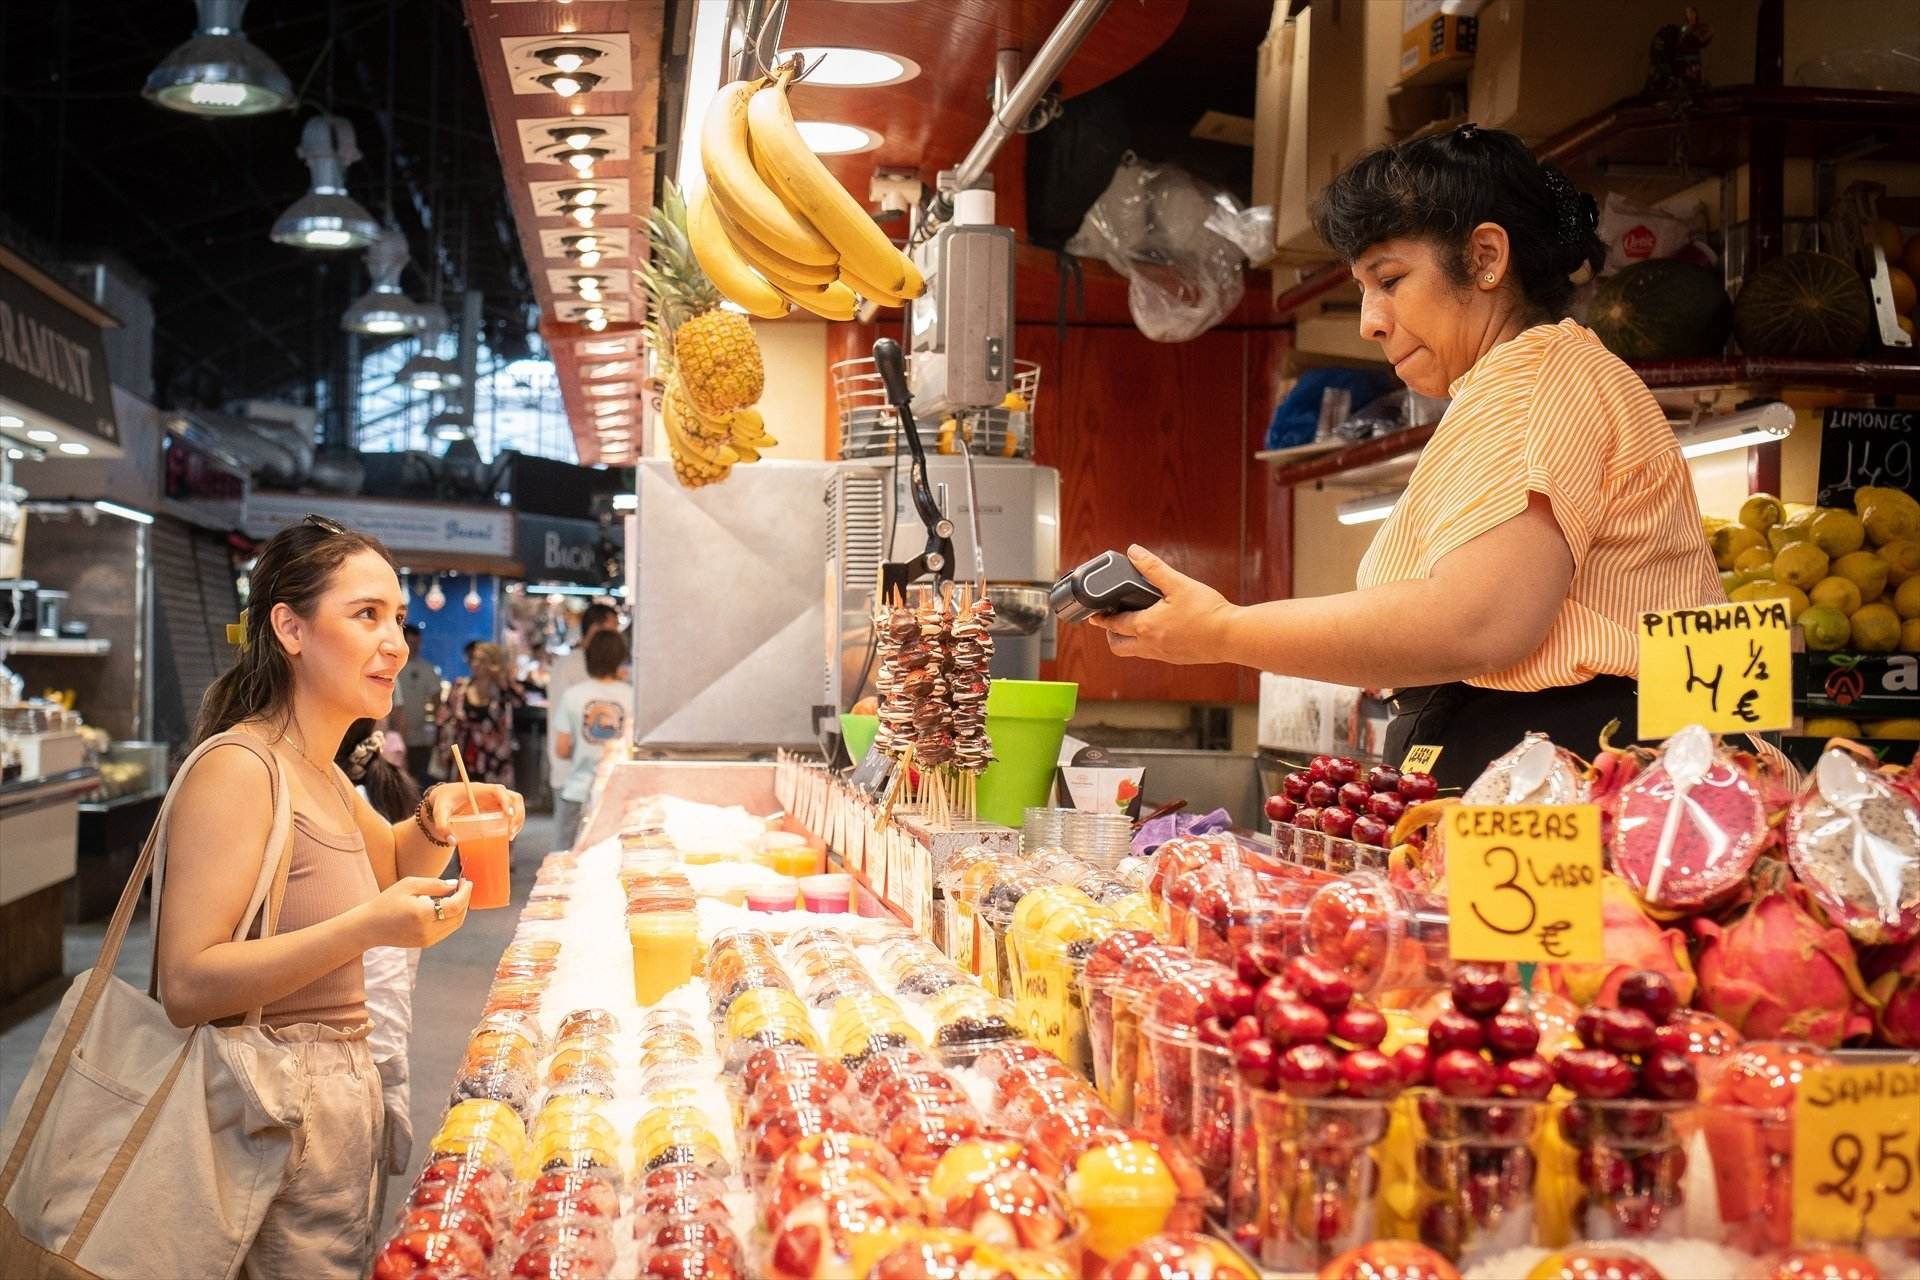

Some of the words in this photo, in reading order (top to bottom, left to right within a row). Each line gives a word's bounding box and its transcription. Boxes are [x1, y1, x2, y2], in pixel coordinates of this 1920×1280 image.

[0, 300, 94, 404] RAMUNT
[1829, 410, 1912, 432] LIMONES
[1642, 603, 1789, 637] PITAHAYA
[1684, 644, 1723, 713] 4
[1731, 689, 1760, 723] €
[1455, 810, 1579, 840] CEREZAS
[1470, 846, 1536, 935] 3
[1534, 920, 1573, 958] €
[1814, 1132, 1920, 1214] 2,5
